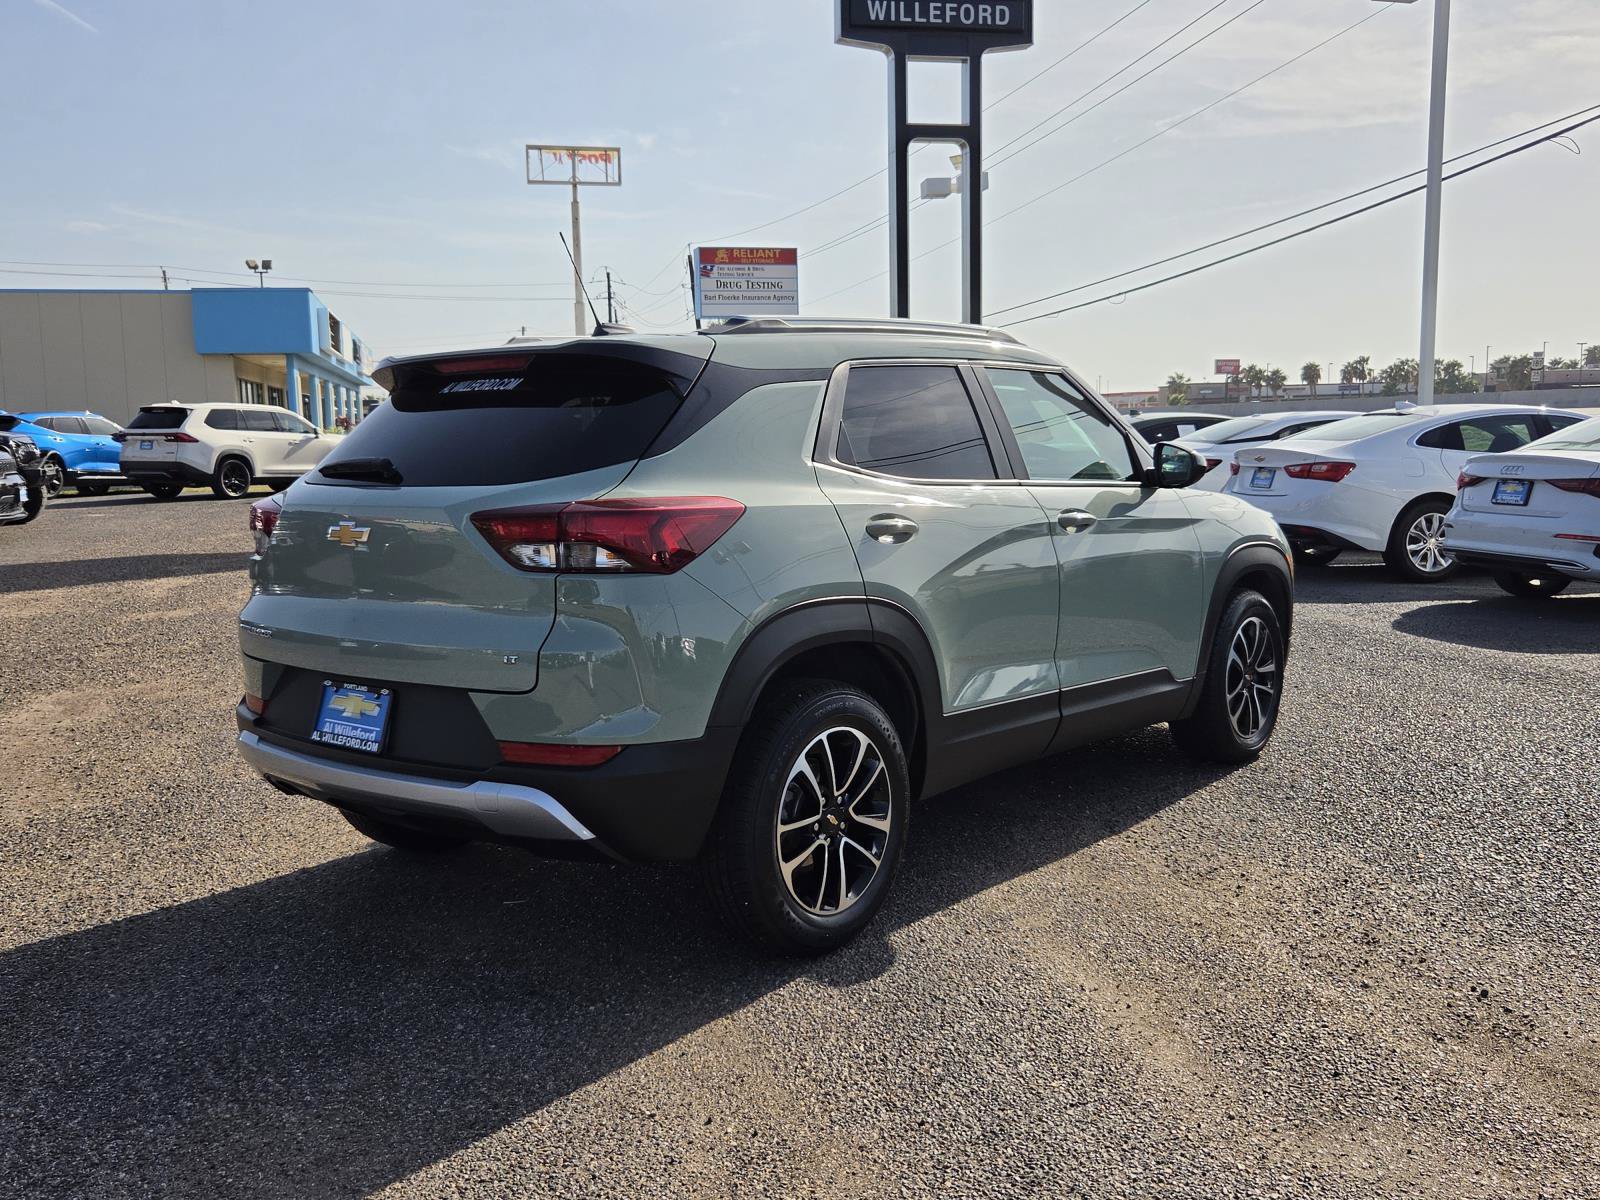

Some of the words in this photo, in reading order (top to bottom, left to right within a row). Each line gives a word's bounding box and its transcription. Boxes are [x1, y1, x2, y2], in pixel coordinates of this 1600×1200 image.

[867, 0, 1010, 25] WILLEFORD
[733, 249, 781, 258] RELIANT
[772, 294, 795, 302] Agency
[344, 683, 368, 692] PORTLAND
[323, 722, 334, 732] Al
[335, 723, 376, 741] Willeford
[311, 730, 321, 741] AL
[322, 731, 379, 752] WILLEFORD.COM
